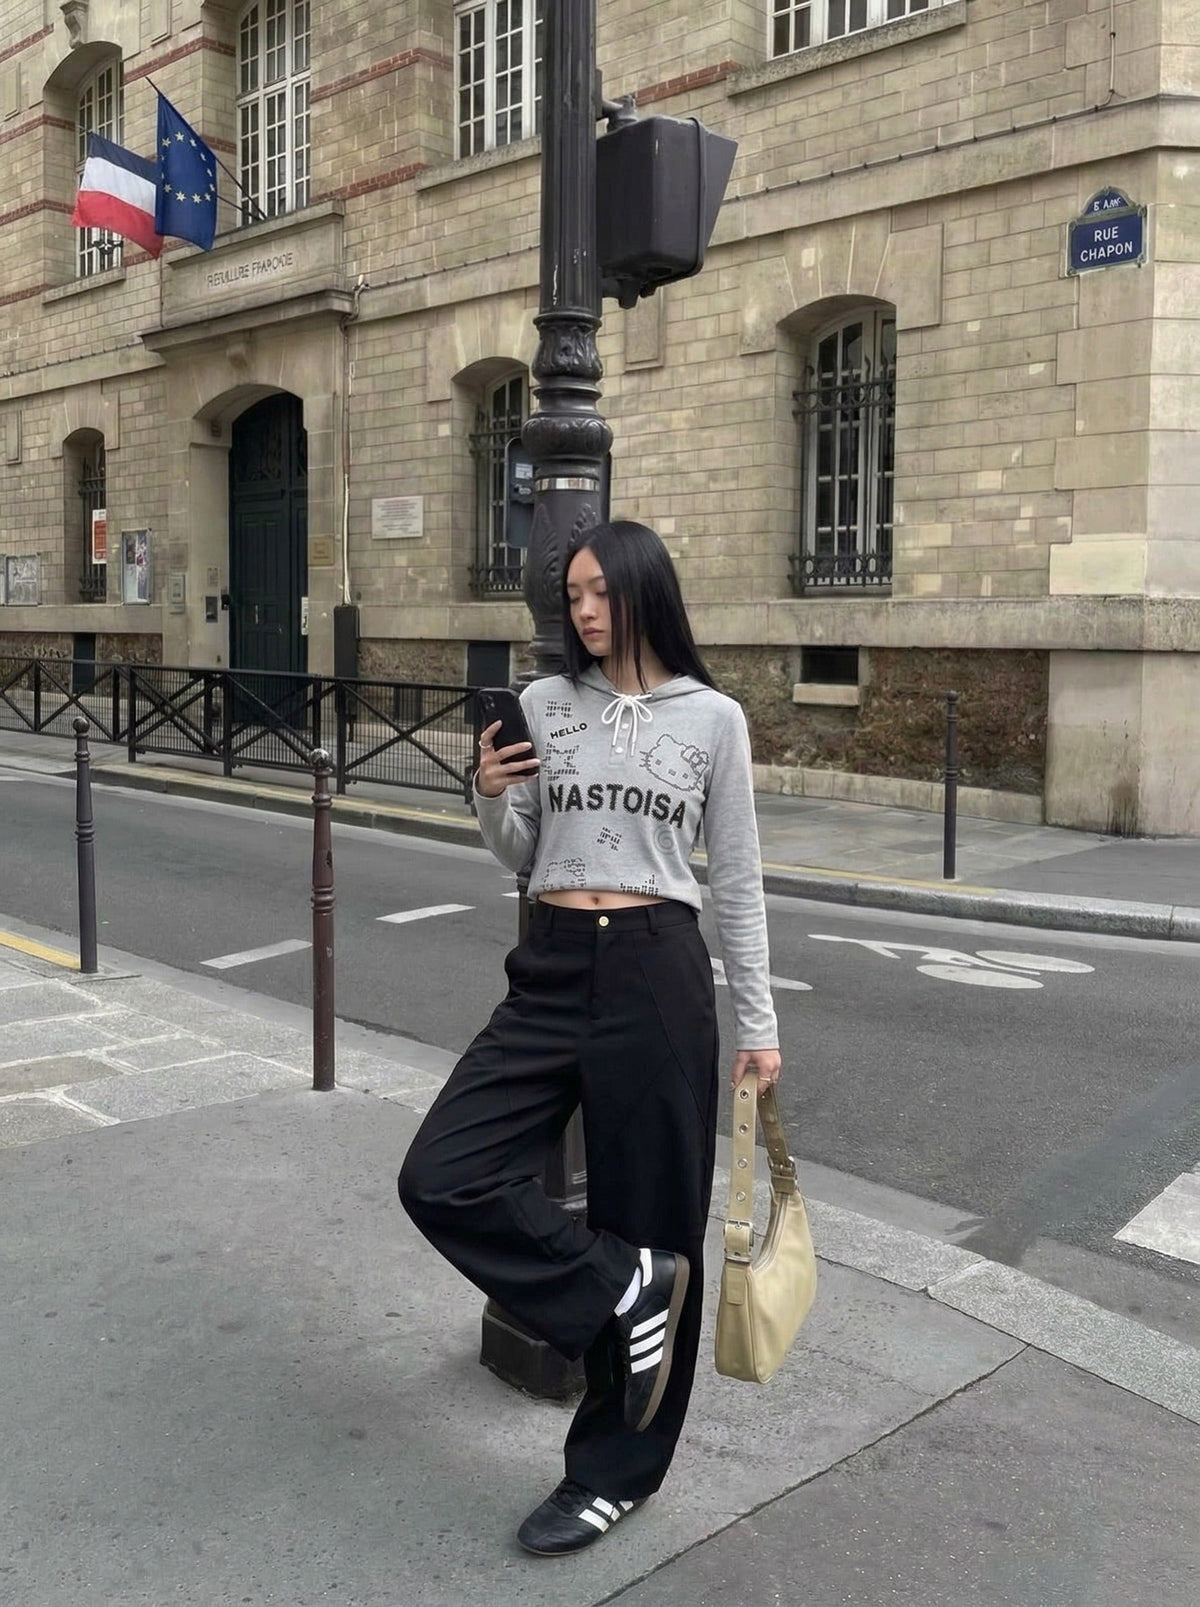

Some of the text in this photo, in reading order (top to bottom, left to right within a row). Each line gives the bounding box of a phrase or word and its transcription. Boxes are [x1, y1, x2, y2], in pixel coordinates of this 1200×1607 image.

[1094, 226, 1119, 242] RUE
[1080, 241, 1133, 262] CHAPON
[550, 722, 588, 740] HELLO
[548, 782, 687, 830] NASTOISA
